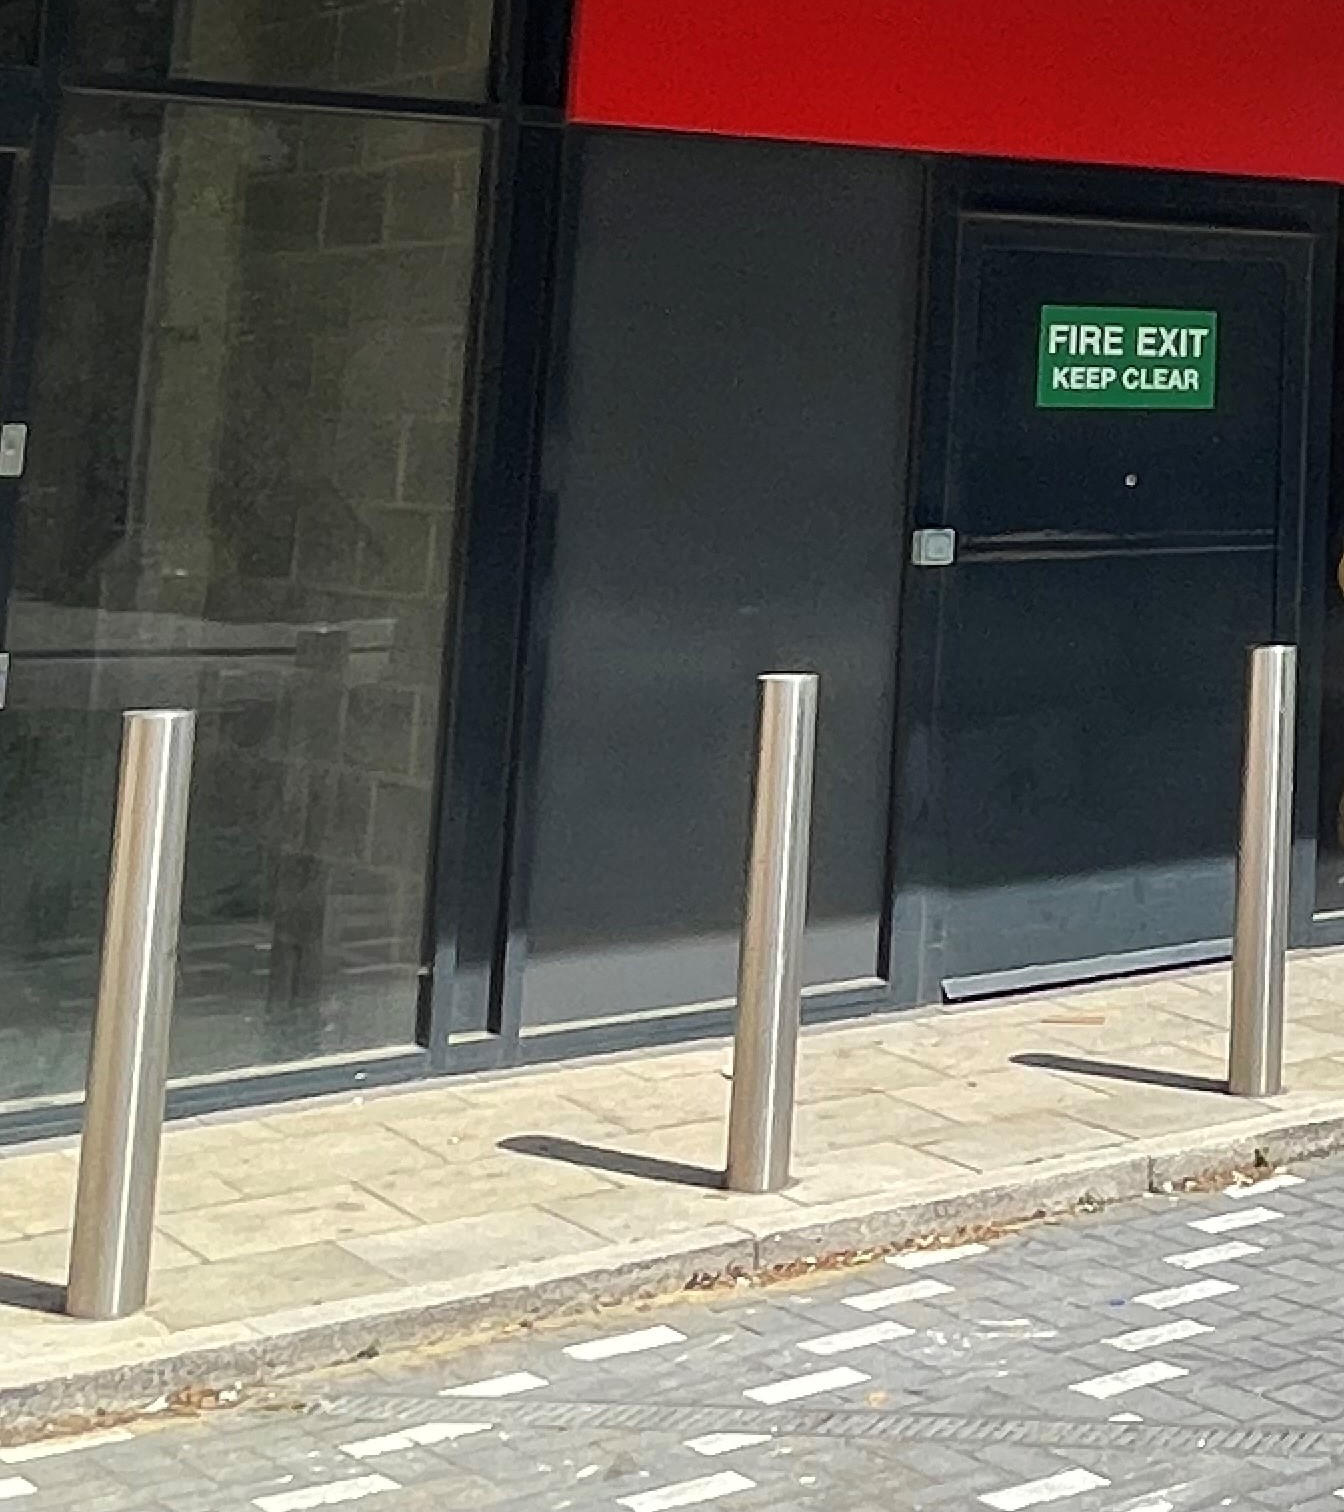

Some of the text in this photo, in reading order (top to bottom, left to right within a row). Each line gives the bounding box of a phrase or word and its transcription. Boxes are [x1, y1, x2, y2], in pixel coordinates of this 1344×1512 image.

[1048, 324, 1210, 358] FIRE EXIT
[1052, 366, 1200, 391] KEEP CLEAR
